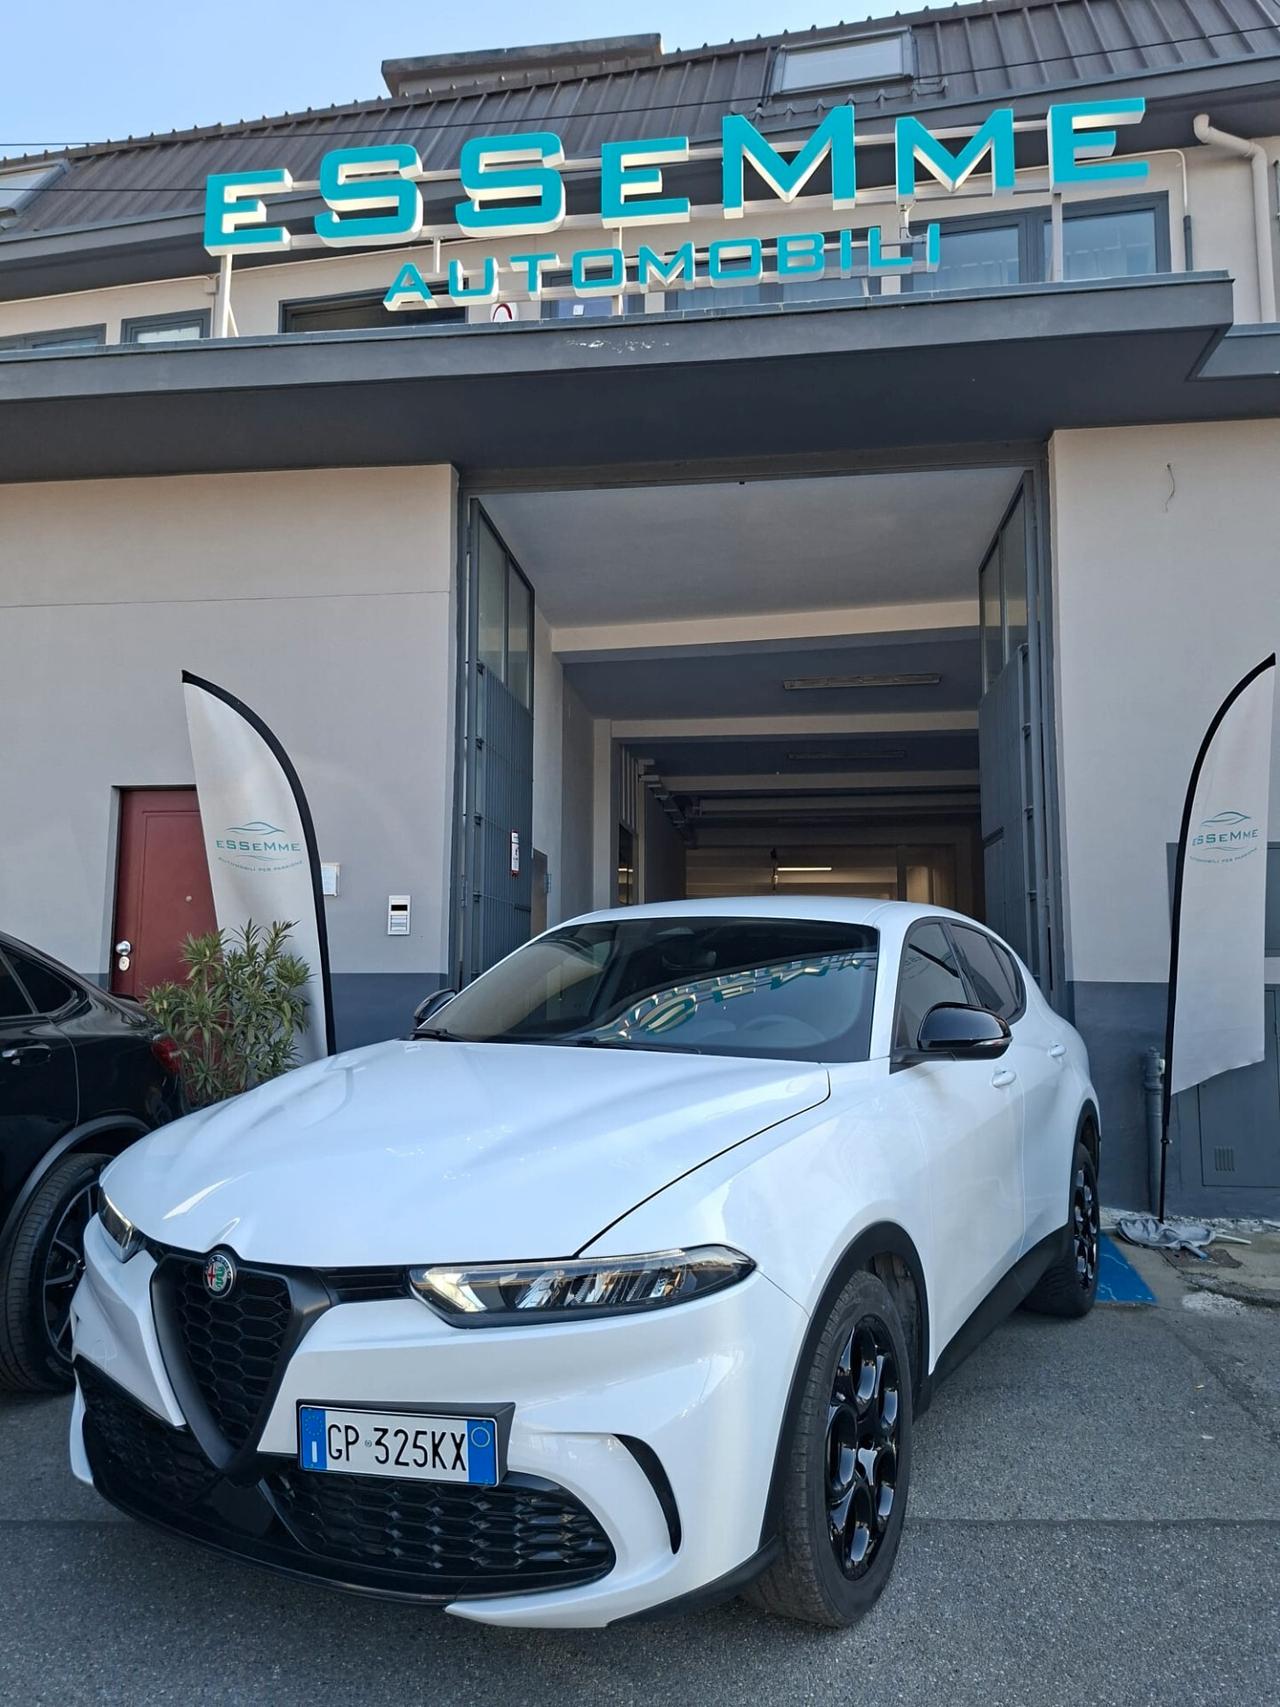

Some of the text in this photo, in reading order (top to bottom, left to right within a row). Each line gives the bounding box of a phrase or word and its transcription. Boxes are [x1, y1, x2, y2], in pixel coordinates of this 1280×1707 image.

[203, 97, 1149, 256] ESSEMME
[384, 223, 942, 310] AUTOMOBILI
[216, 840, 301, 852] ESSEMME
[328, 1424, 467, 1471] GP 325KX
